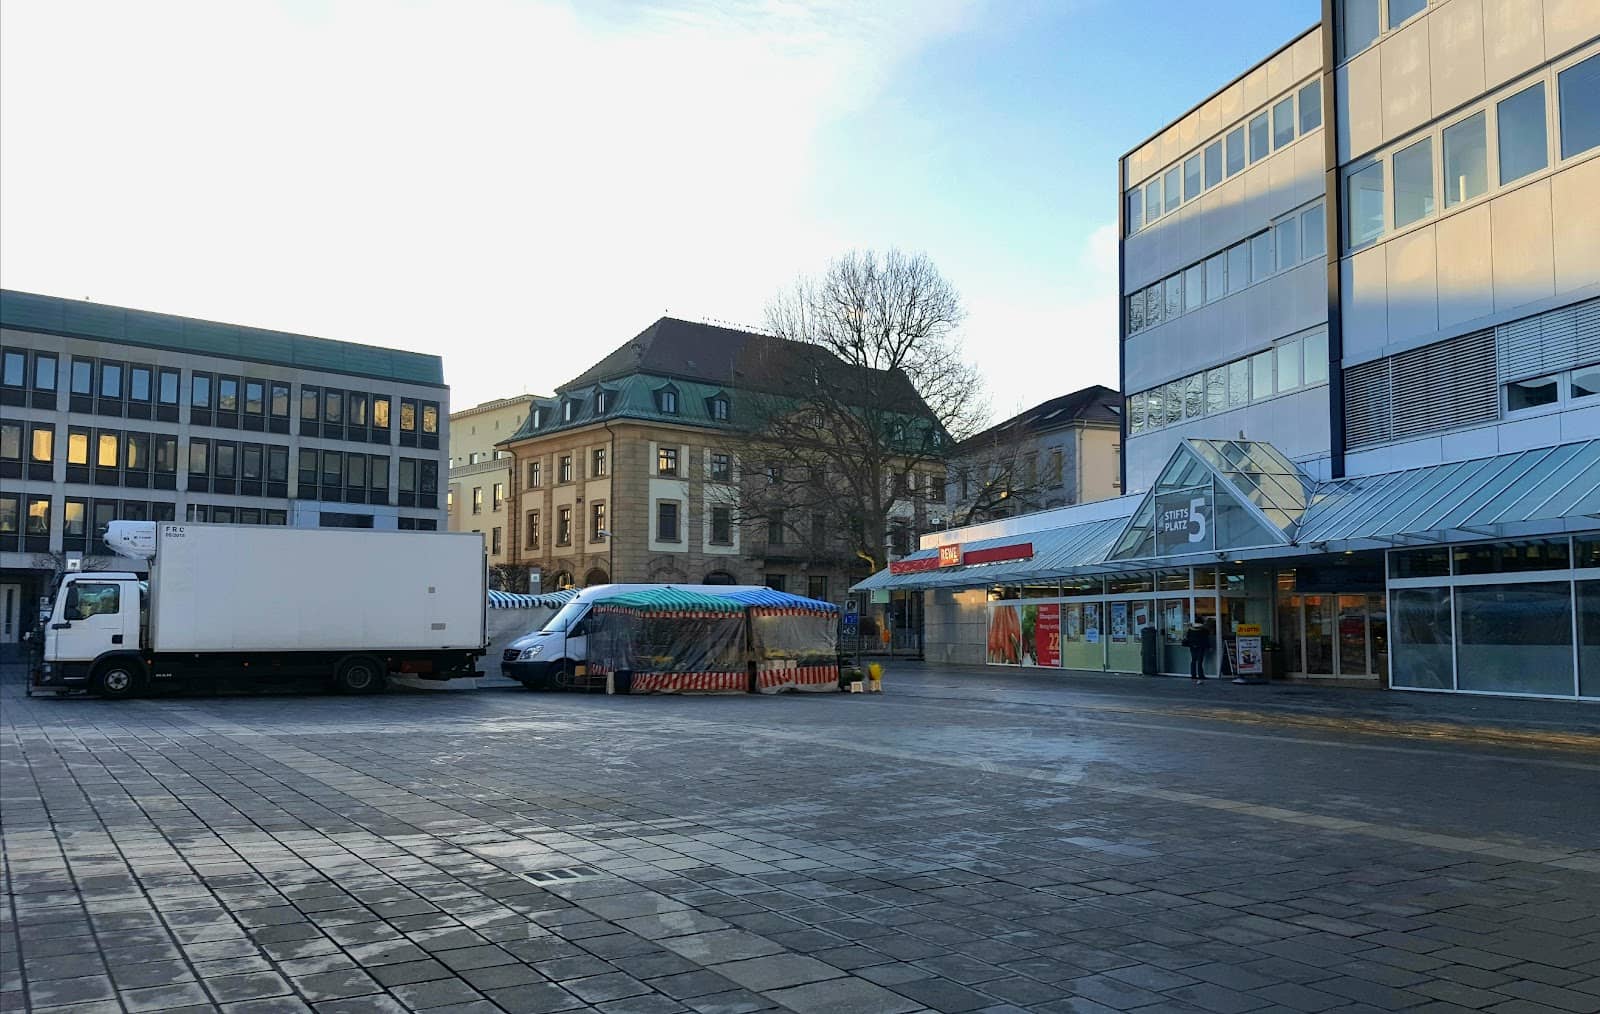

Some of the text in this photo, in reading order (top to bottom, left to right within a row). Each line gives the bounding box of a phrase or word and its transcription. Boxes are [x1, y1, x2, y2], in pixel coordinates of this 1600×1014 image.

[1164, 508, 1189, 521] STIFTS
[1189, 497, 1206, 543] 5
[1165, 520, 1188, 532] PLATZ
[940, 546, 958, 561] REWE
